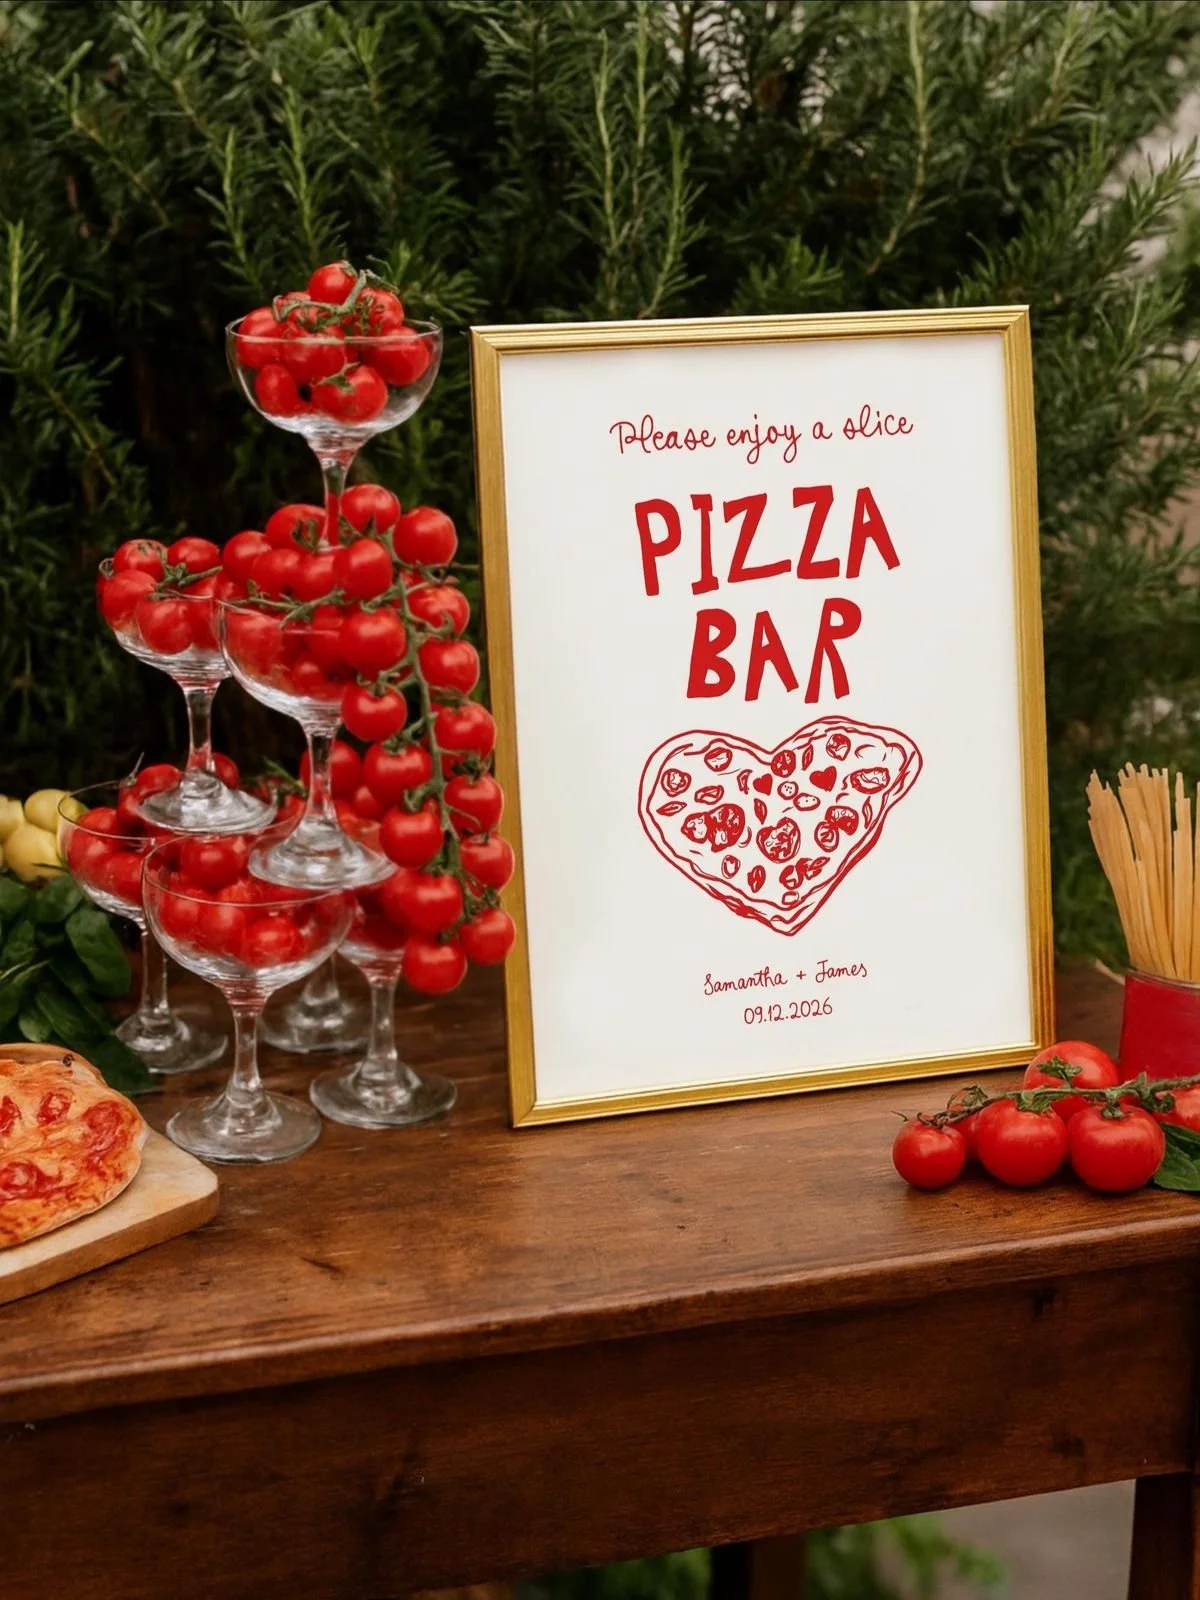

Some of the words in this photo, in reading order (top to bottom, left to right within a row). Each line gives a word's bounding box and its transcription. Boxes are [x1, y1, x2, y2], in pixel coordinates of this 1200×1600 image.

[607, 414, 716, 454] Please
[726, 414, 802, 464] enjoy
[812, 421, 833, 440] a
[843, 404, 914, 440] slice
[634, 484, 901, 597] PIZZA
[686, 597, 862, 704] BAR
[704, 966, 788, 996] Samantha
[796, 970, 807, 980] +
[815, 959, 868, 983] James
[744, 997, 833, 1025] 09.12.2026
